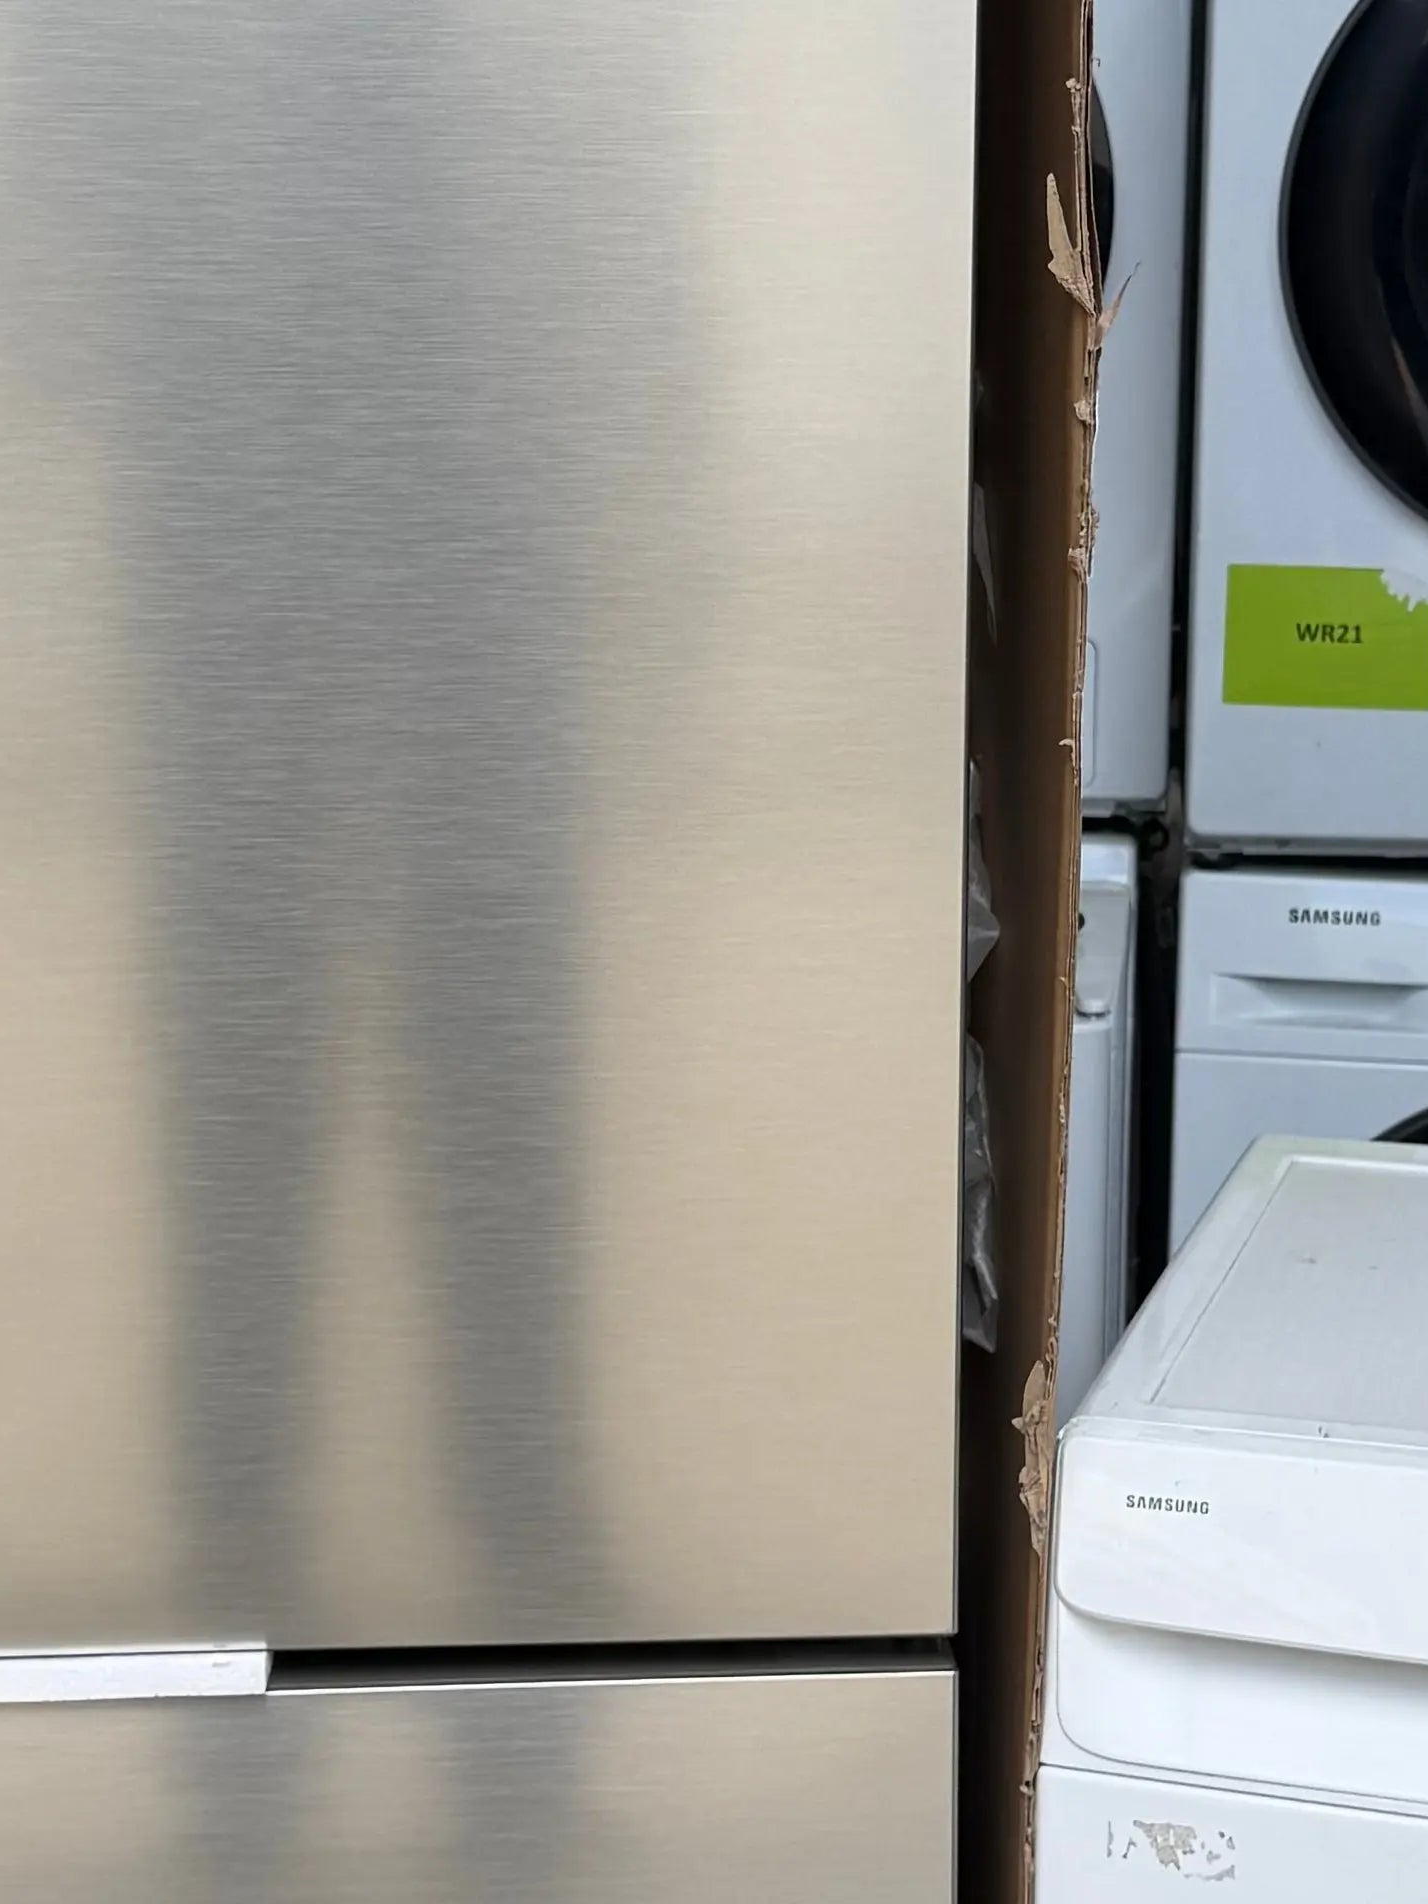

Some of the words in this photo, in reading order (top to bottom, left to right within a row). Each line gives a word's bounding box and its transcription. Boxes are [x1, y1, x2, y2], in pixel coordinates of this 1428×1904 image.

[1296, 623, 1363, 644] WR21
[1289, 908, 1381, 926] SAMSUNG
[1126, 1495, 1209, 1514] SAMSUNG
